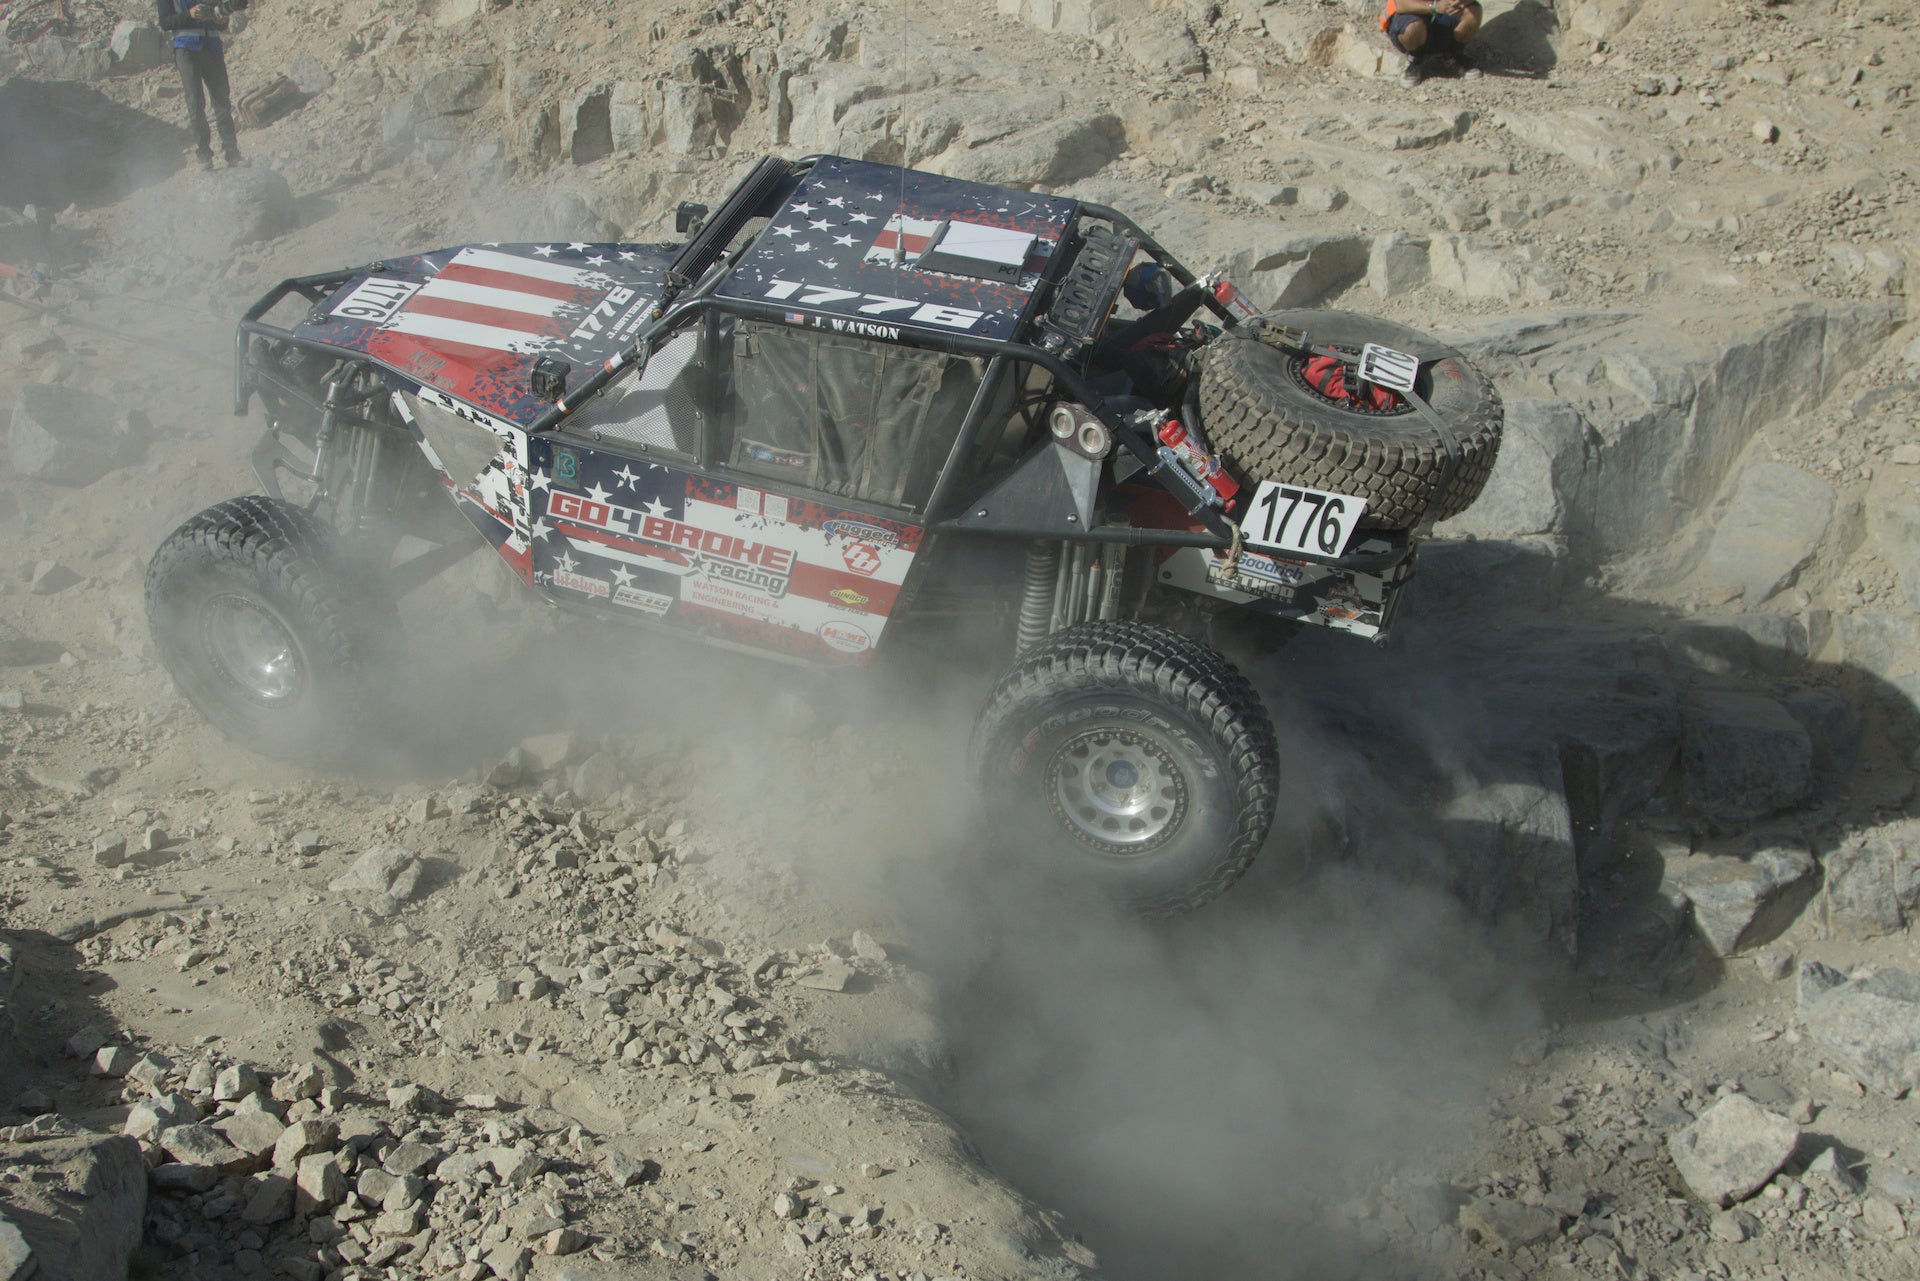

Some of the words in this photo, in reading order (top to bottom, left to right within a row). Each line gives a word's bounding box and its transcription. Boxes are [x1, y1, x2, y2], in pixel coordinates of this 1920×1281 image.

[998, 265, 1018, 277] PCI
[341, 283, 413, 319] 1776
[569, 285, 636, 340] 1776
[764, 279, 985, 330] 1776
[811, 316, 827, 329] J.
[831, 318, 901, 341] WATSON
[1363, 346, 1416, 390] 1776
[1260, 486, 1346, 554] 1776
[692, 580, 734, 598] WATSON
[735, 590, 772, 607] RACING
[772, 599, 780, 609] &
[707, 558, 785, 595] racing
[692, 592, 755, 614] ENGINEERING
[832, 589, 868, 604] SUNOCO
